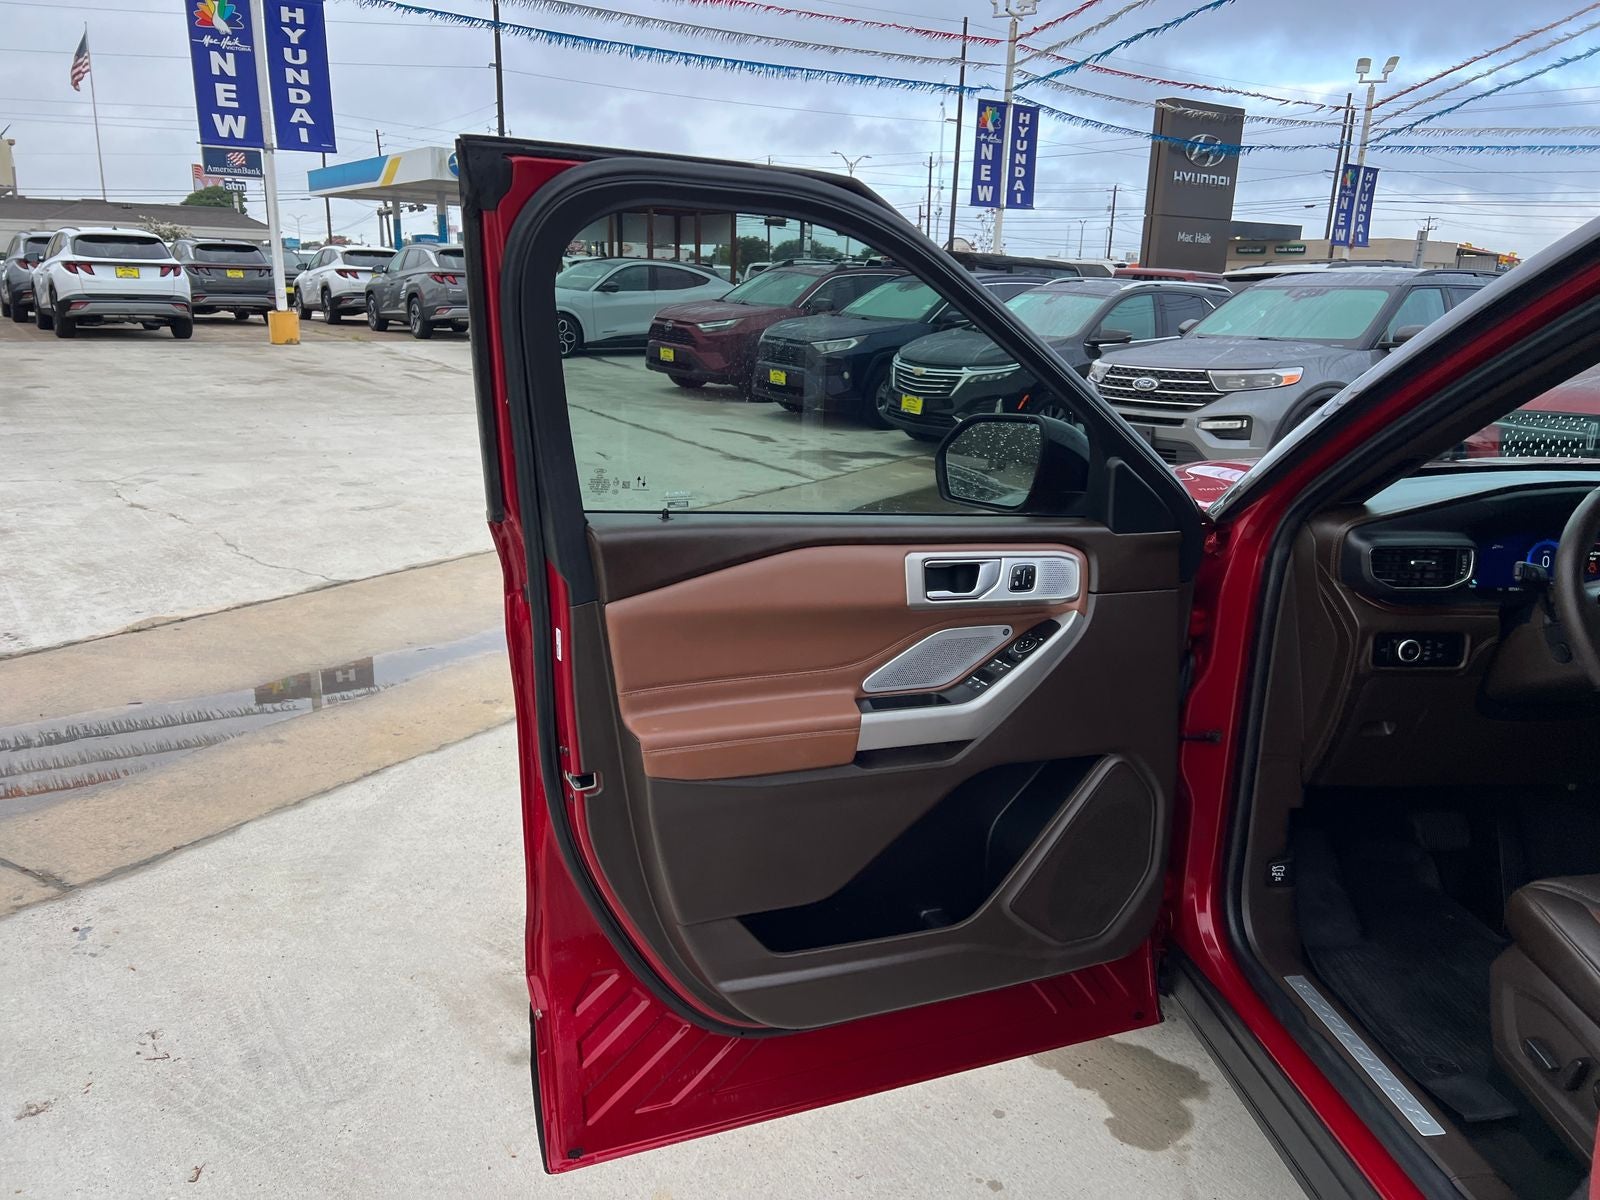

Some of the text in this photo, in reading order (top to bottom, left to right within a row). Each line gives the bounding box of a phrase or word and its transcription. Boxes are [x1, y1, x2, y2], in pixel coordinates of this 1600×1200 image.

[194, 34, 220, 47] Mac
[209, 51, 247, 139] NEW
[280, 6, 315, 143] HYUNDAI
[206, 164, 260, 176] AmericanBank
[977, 143, 993, 202] NEW
[1013, 112, 1030, 204] HYUNDAI
[1173, 170, 1230, 187] HYUNDAI
[225, 182, 246, 190] atm
[1356, 172, 1373, 243] HYUNDAI
[1177, 231, 1211, 244] Mac Haik
[1335, 196, 1348, 241] NEW
